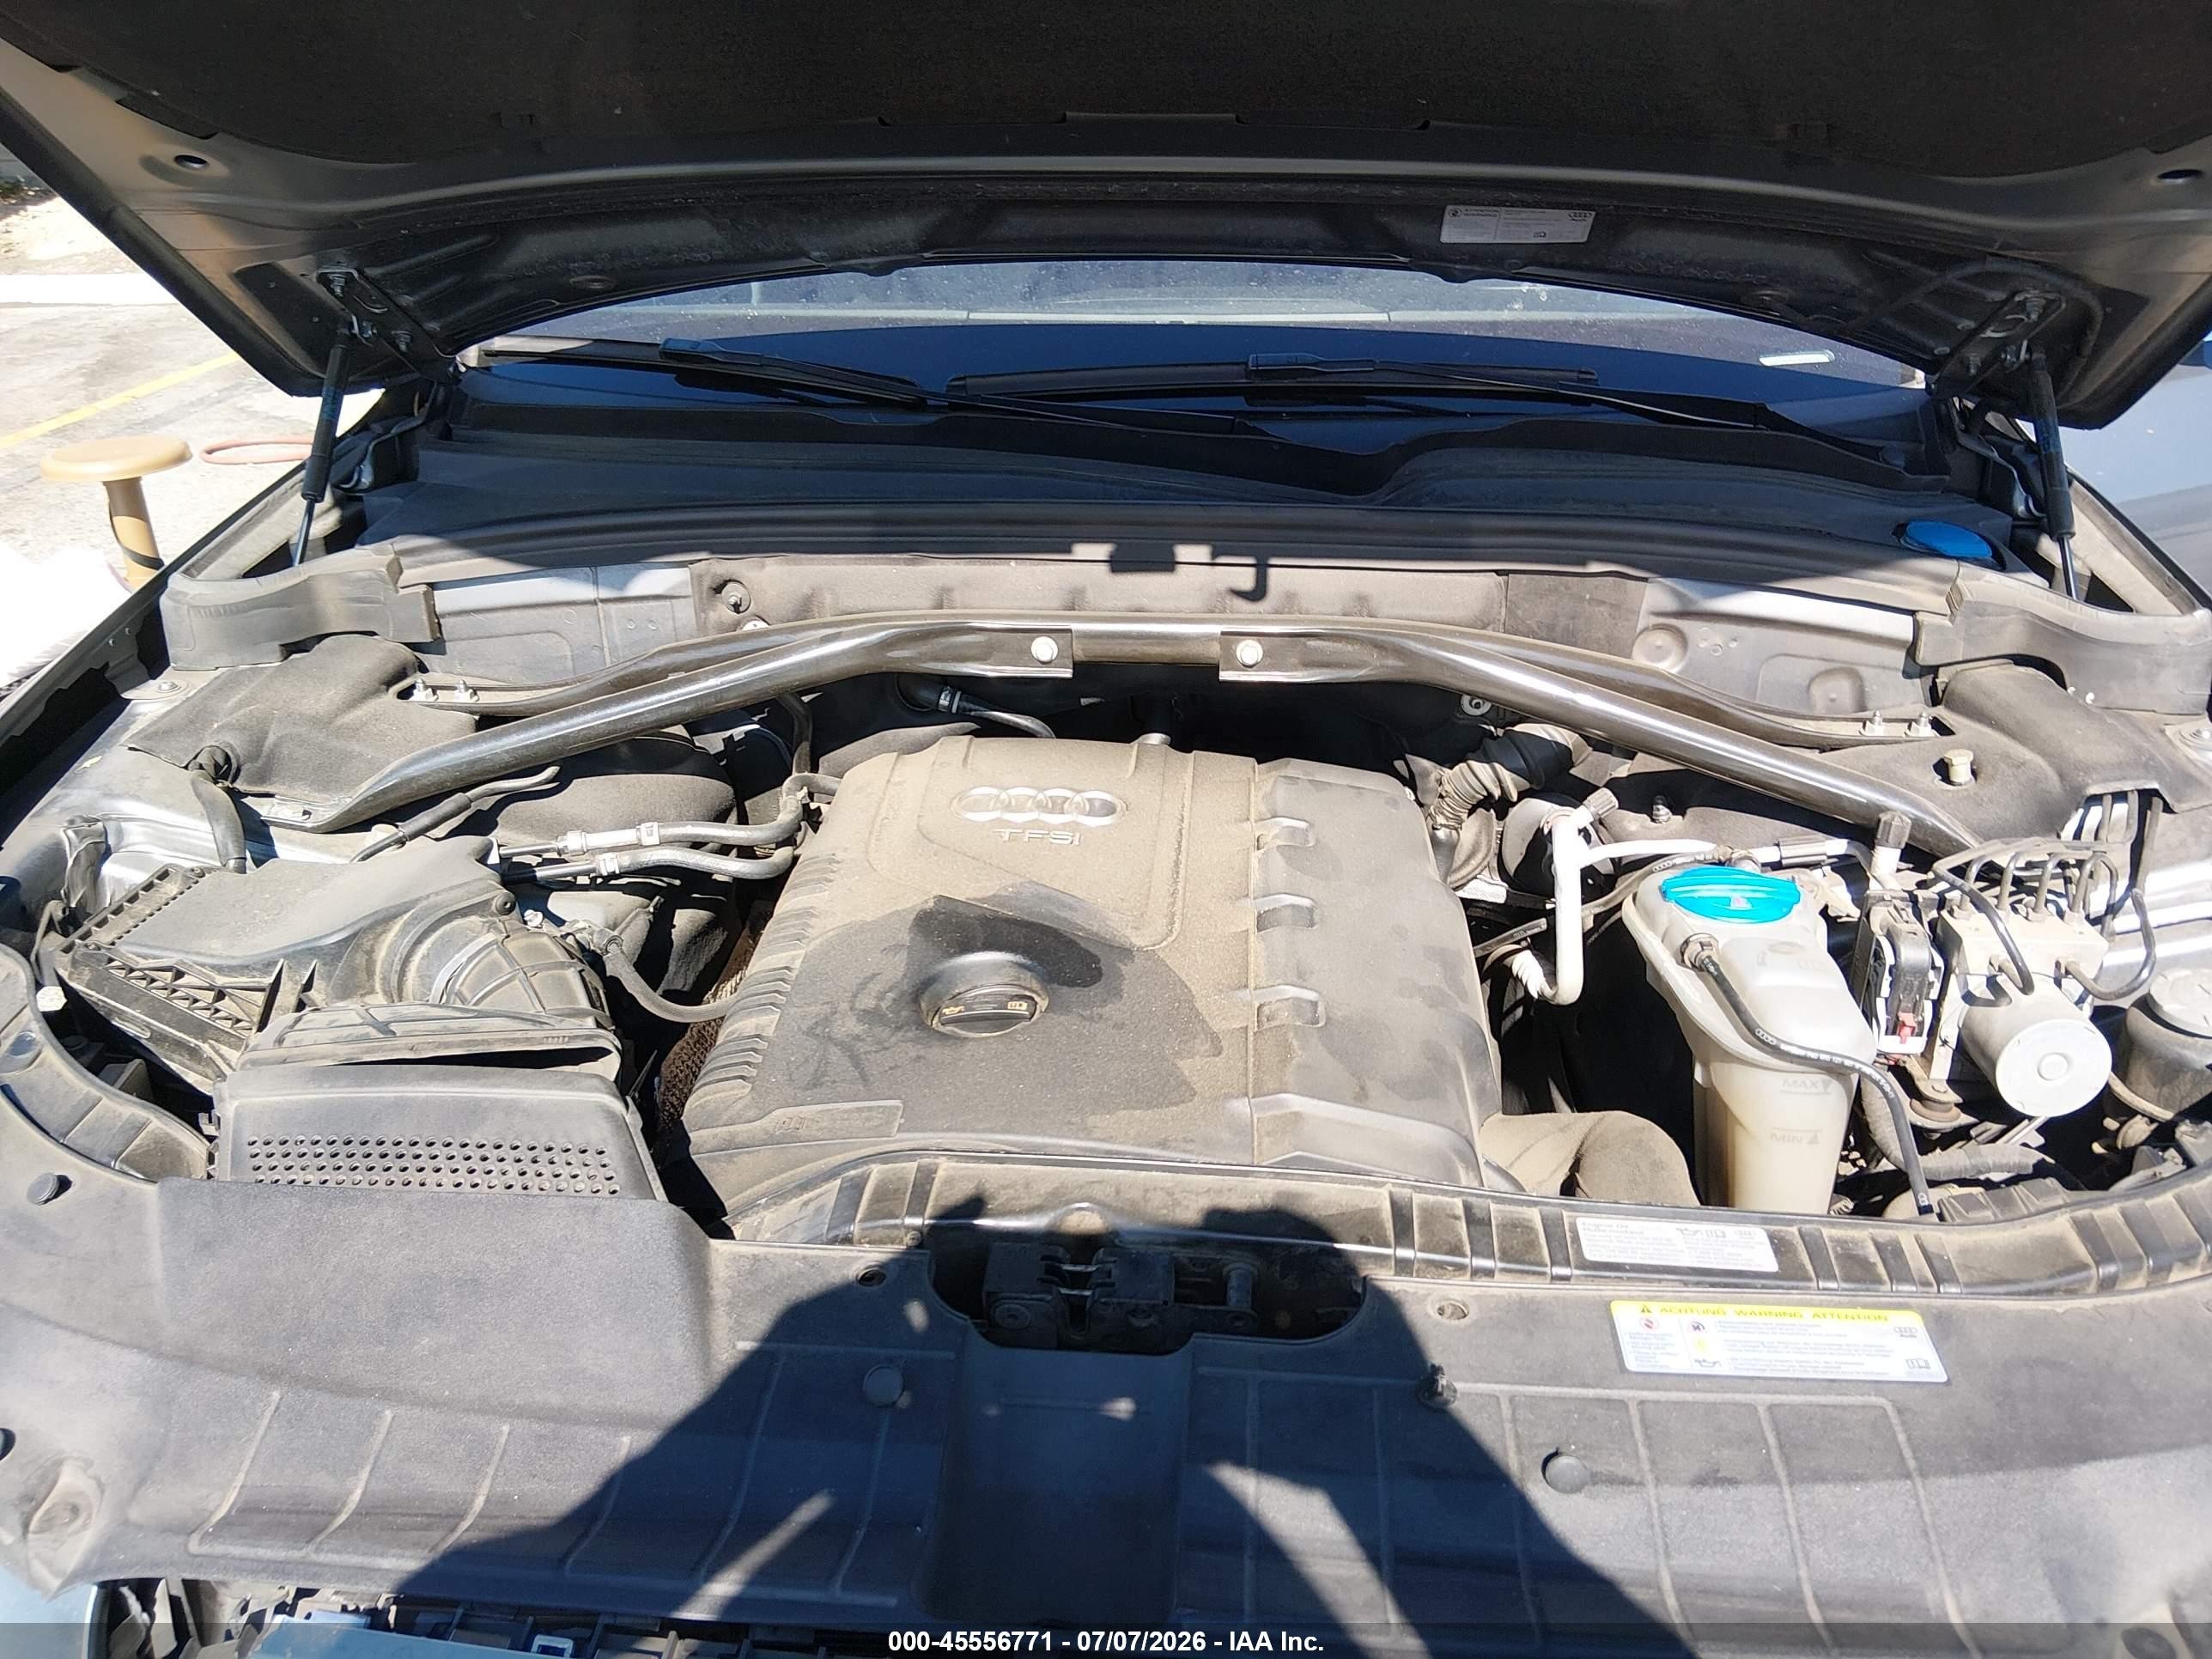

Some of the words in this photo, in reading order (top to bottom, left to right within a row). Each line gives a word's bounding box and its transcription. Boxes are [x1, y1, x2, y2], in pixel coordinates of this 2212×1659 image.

[993, 828, 1082, 846] TFSI
[1782, 1079, 1820, 1090] MAX
[1660, 1305, 1727, 1316] ACHTUNG
[1735, 1309, 1803, 1319] WARNING
[1812, 1311, 1888, 1322] ATTENTION
